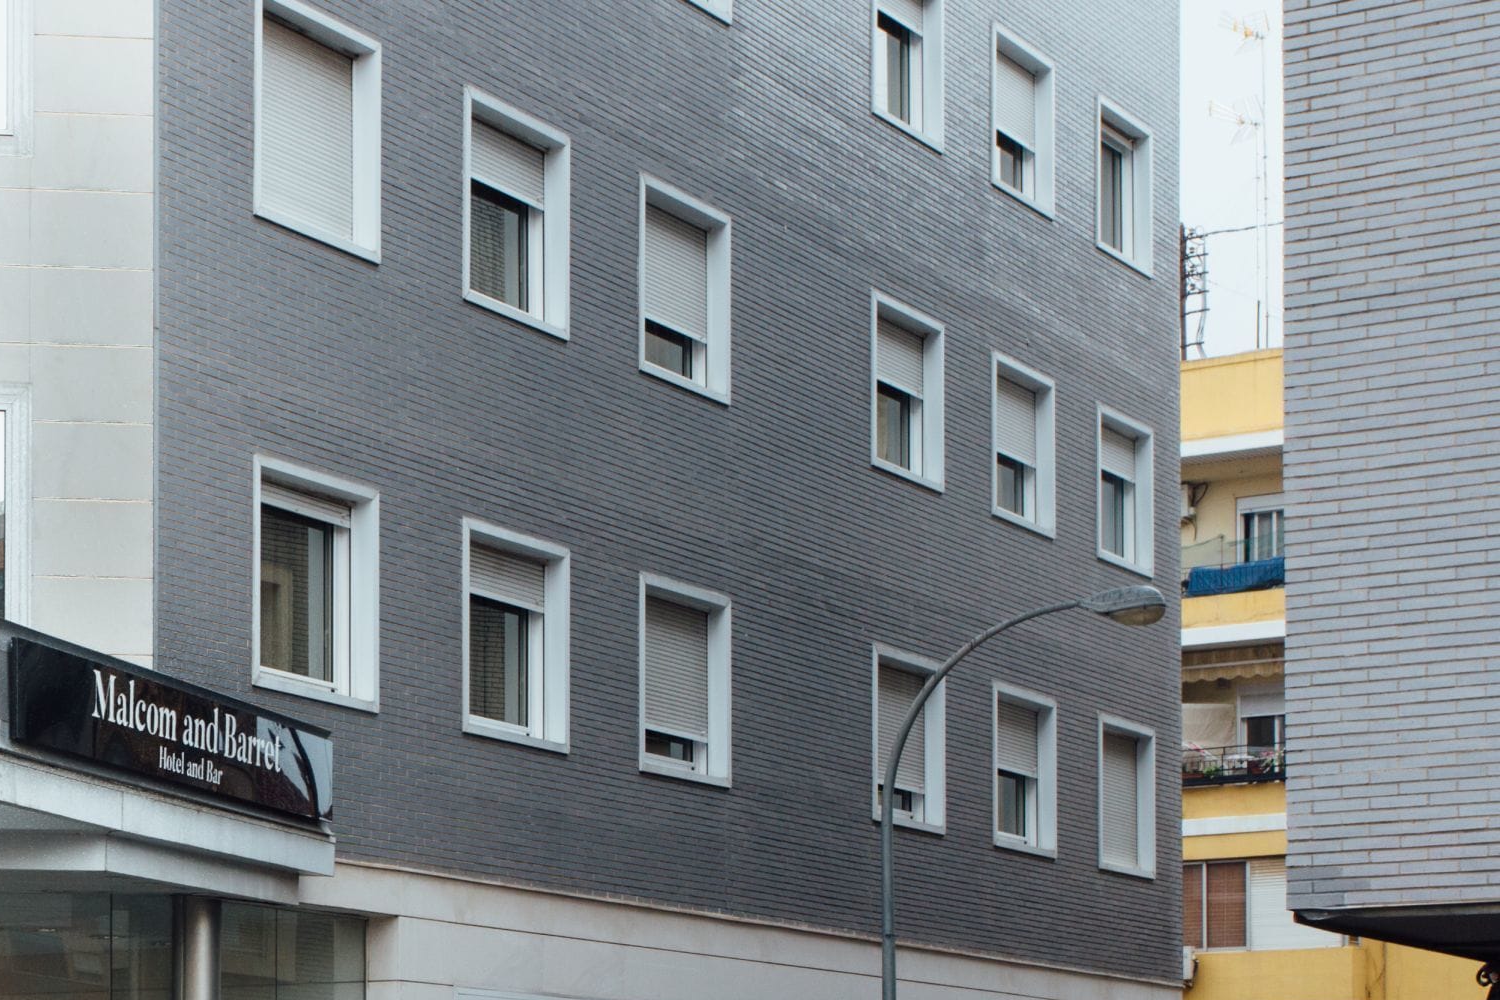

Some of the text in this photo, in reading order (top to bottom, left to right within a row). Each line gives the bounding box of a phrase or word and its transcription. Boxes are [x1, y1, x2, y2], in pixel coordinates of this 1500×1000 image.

[91, 669, 283, 773] Malcom and Barret
[159, 745, 224, 785] Hotel and Bar
